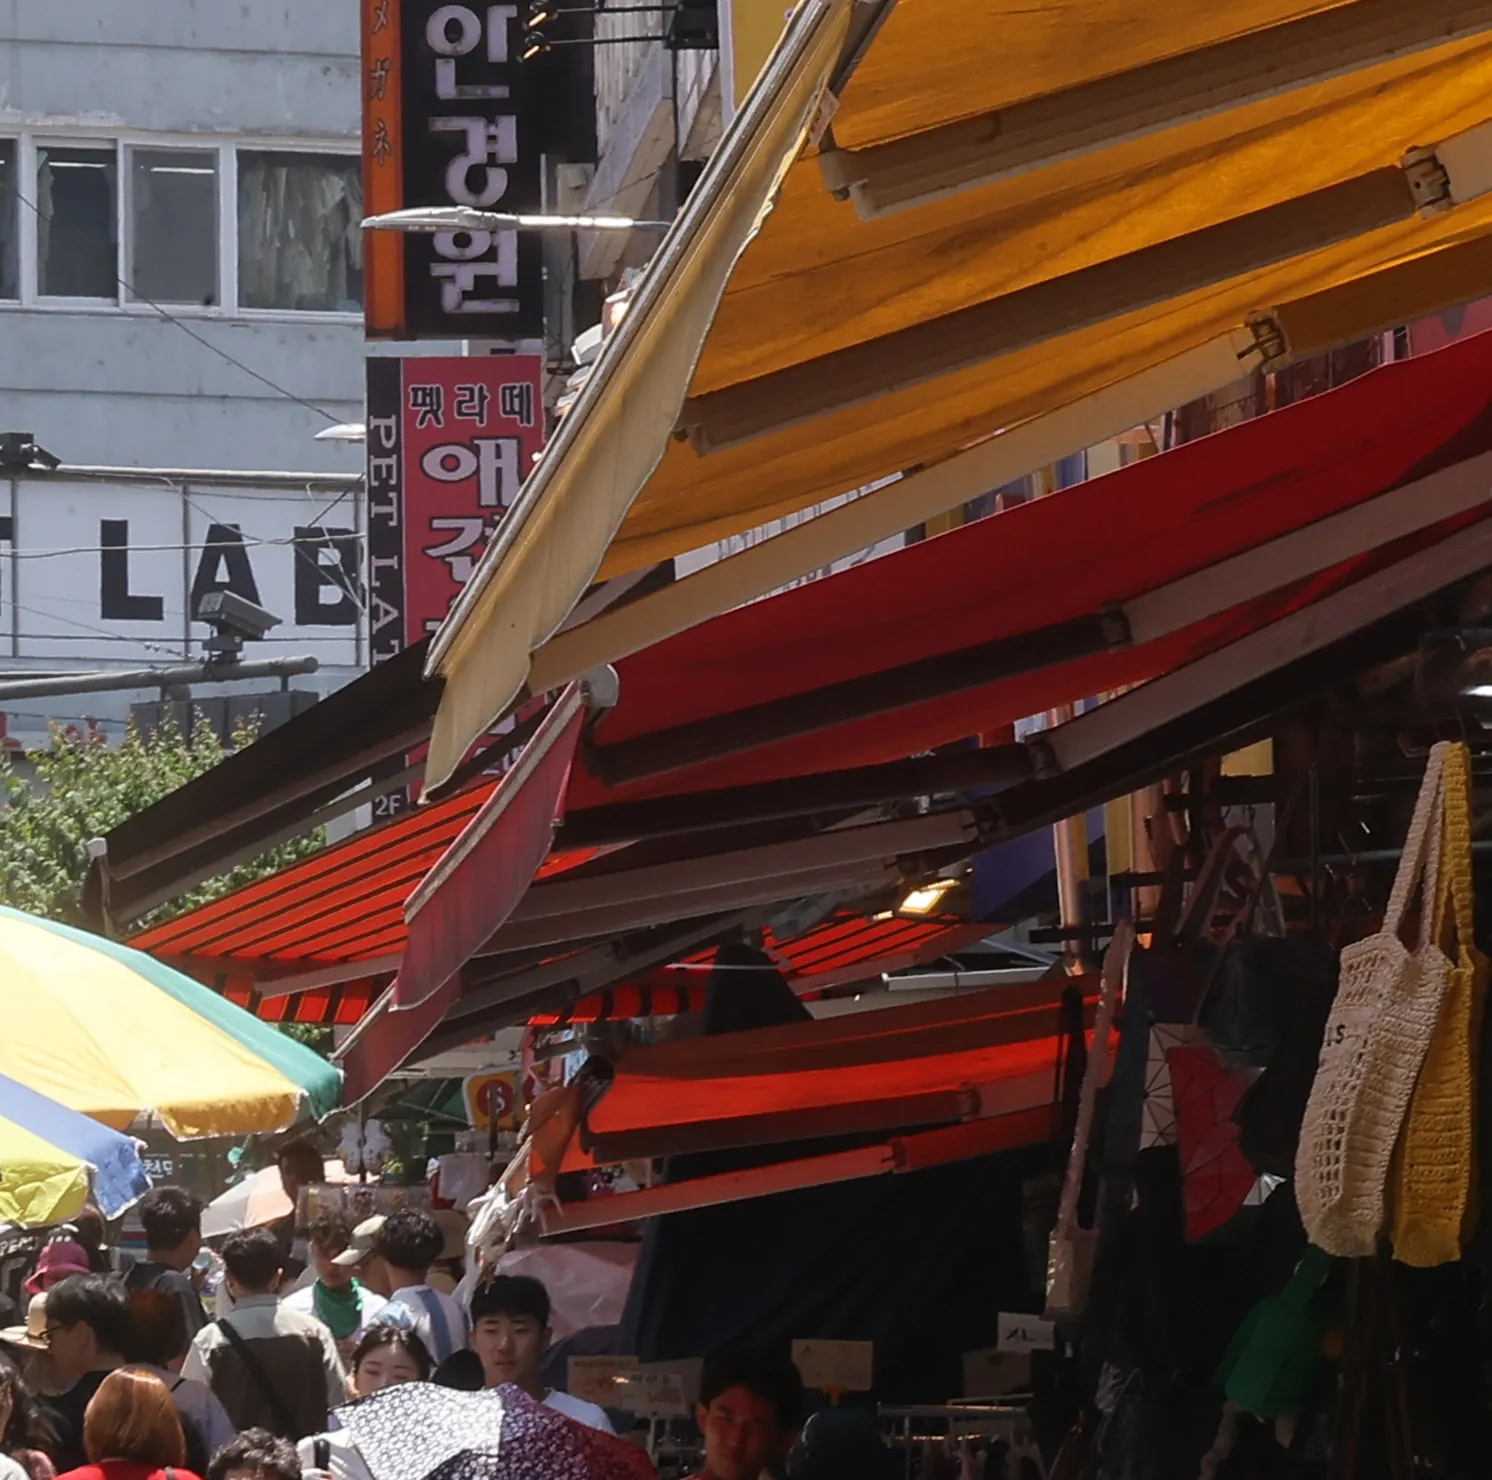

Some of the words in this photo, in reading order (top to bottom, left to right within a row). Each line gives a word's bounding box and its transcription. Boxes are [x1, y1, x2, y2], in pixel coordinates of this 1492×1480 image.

[425, 4, 520, 314] 안경원
[408, 381, 536, 428] 펫라떼
[369, 414, 398, 527] PET
[100, 518, 360, 627] LAB
[375, 794, 401, 817] 2F
